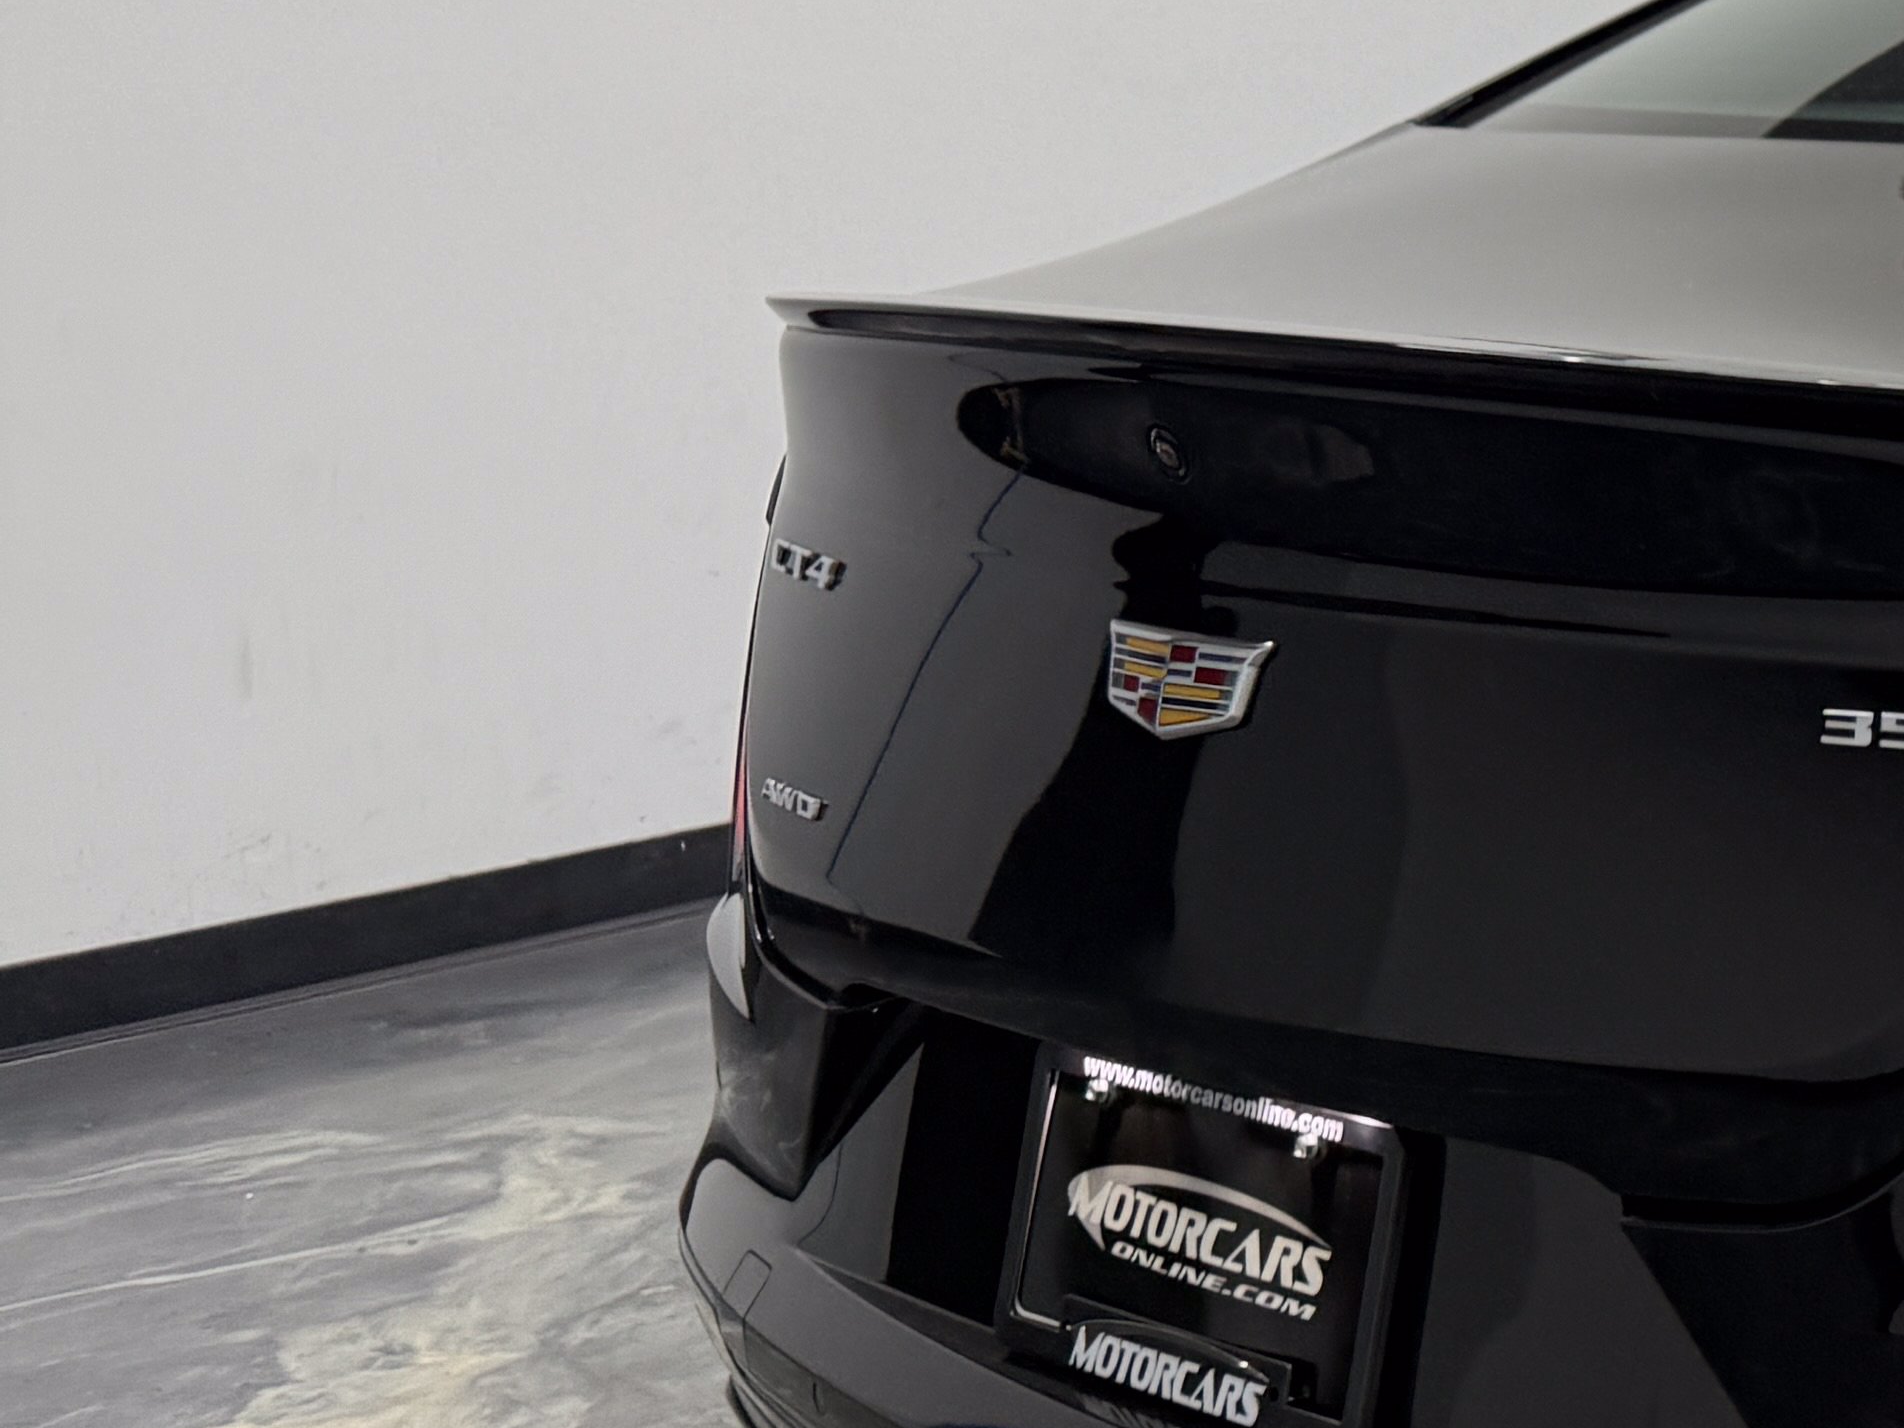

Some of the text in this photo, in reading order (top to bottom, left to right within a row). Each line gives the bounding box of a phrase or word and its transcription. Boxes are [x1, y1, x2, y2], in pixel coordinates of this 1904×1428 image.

[771, 538, 843, 590] CT4
[760, 777, 824, 822] AWD
[1083, 1056, 1344, 1143] www.motorcarsonline.com
[1067, 1170, 1332, 1297] MOTORCARS
[1111, 1240, 1317, 1321] ONLINE.COM
[1068, 1325, 1268, 1428] MOTORCARS
